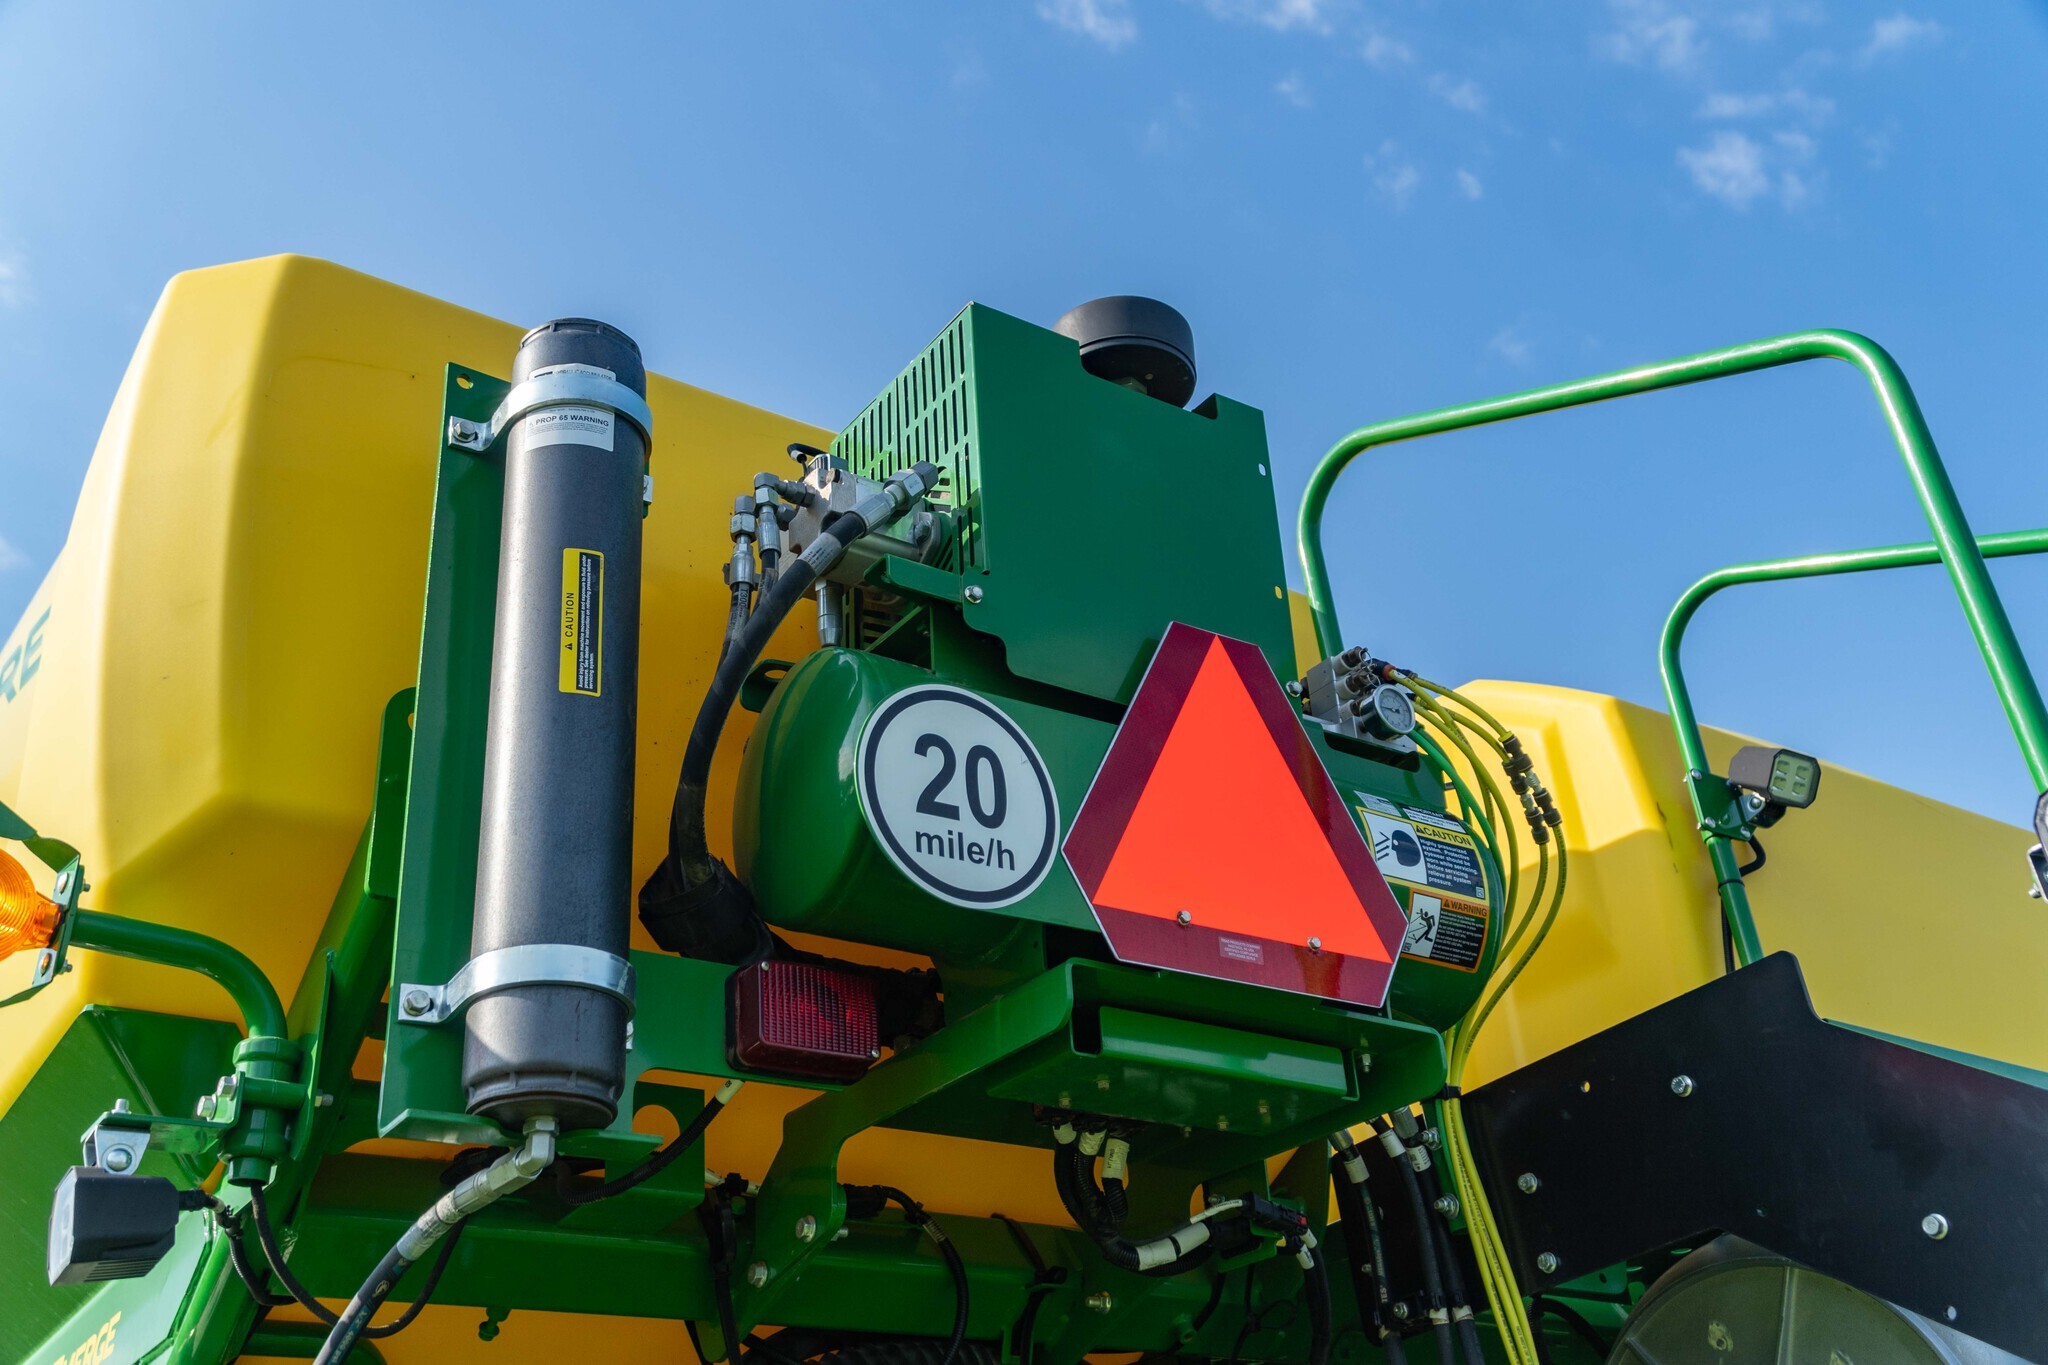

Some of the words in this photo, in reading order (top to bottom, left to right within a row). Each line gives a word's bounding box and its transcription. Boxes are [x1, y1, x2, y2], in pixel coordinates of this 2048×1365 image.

[536, 415, 557, 425] PROP
[570, 415, 609, 427] WARNING
[565, 592, 575, 637] CAUTION
[914, 733, 1007, 829] 20
[1423, 827, 1472, 846] CAUTION
[915, 829, 1015, 871] mile/h
[1420, 839, 1437, 848] Highly
[1437, 843, 1467, 855] pressurized
[1444, 850, 1470, 860] Protective
[1424, 851, 1445, 859] eyewear
[1446, 856, 1464, 864] should
[1439, 860, 1453, 868] while
[1426, 862, 1444, 871] Before
[1445, 868, 1469, 879] servicing
[1428, 870, 1445, 878] relieve
[1453, 876, 1472, 884] system
[1428, 876, 1453, 887] pressure.
[1451, 900, 1487, 916] WARNING
